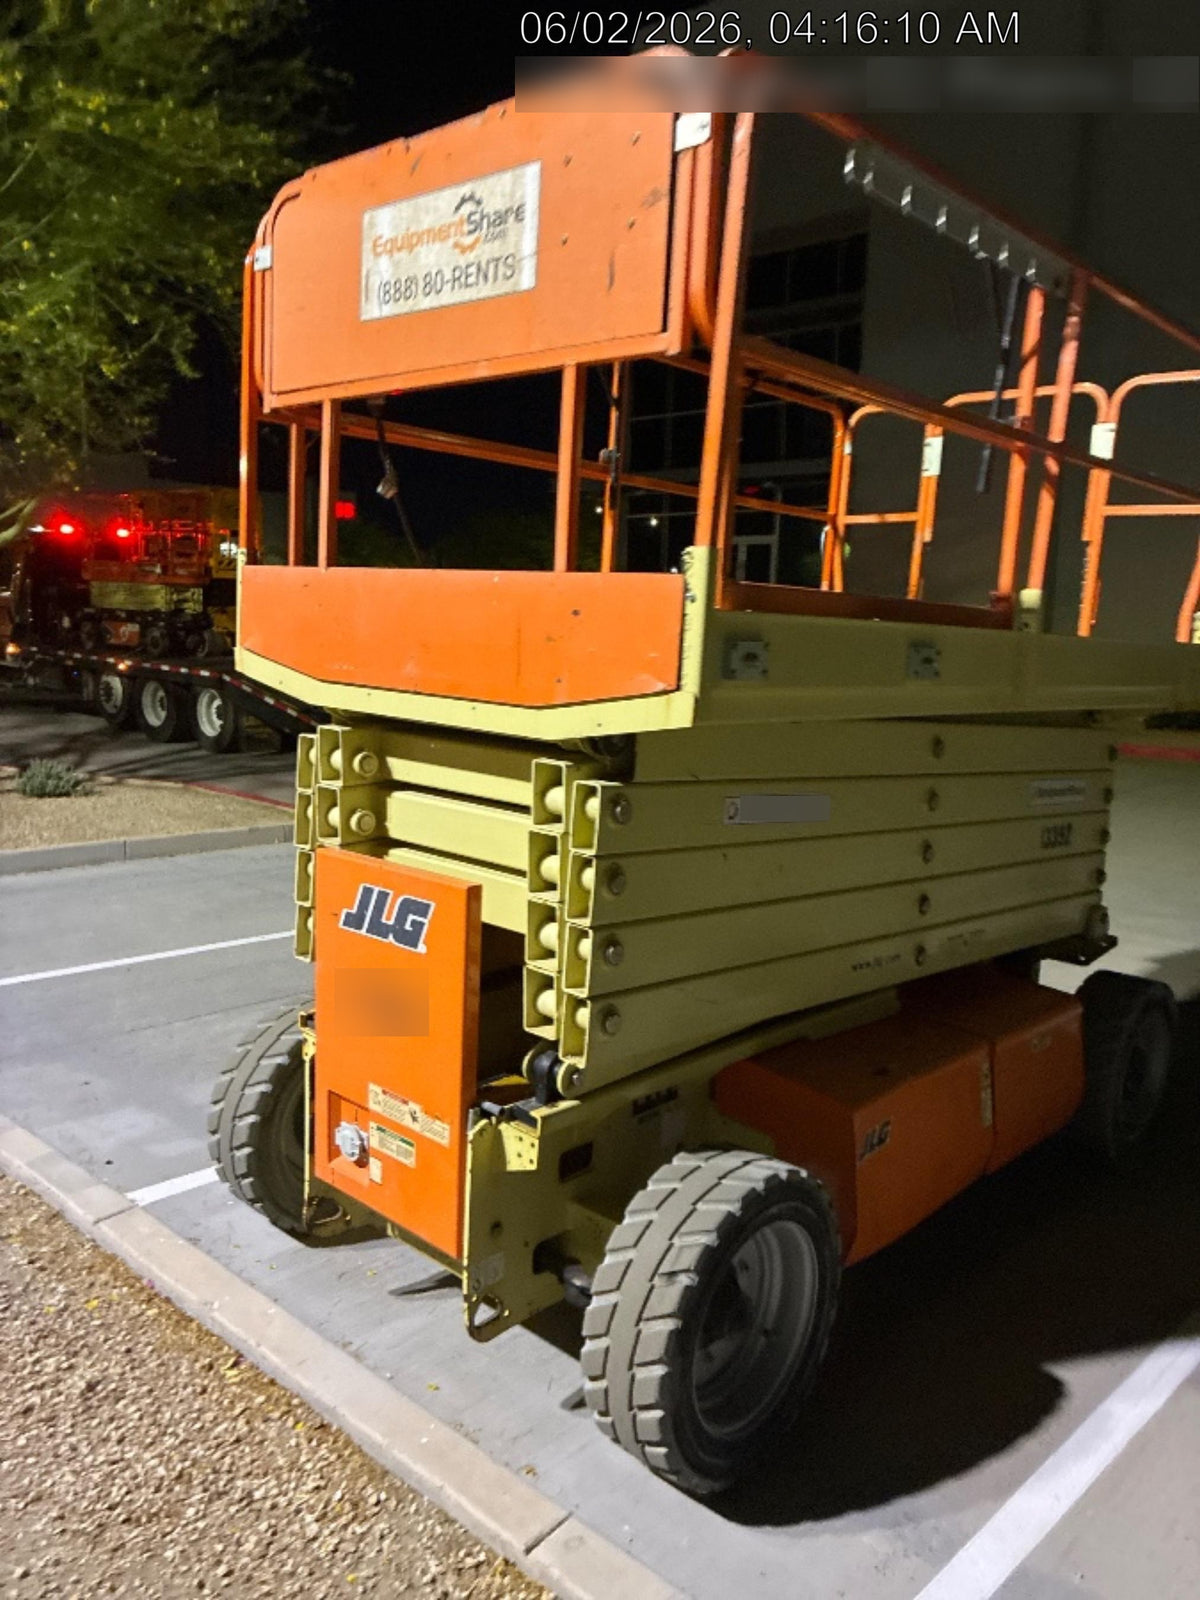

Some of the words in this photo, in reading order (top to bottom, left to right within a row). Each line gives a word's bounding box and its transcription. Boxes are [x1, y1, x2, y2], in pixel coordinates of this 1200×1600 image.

[378, 273, 419, 305] (888)
[422, 253, 517, 297] 80-RENTS
[339, 883, 436, 953] JLG
